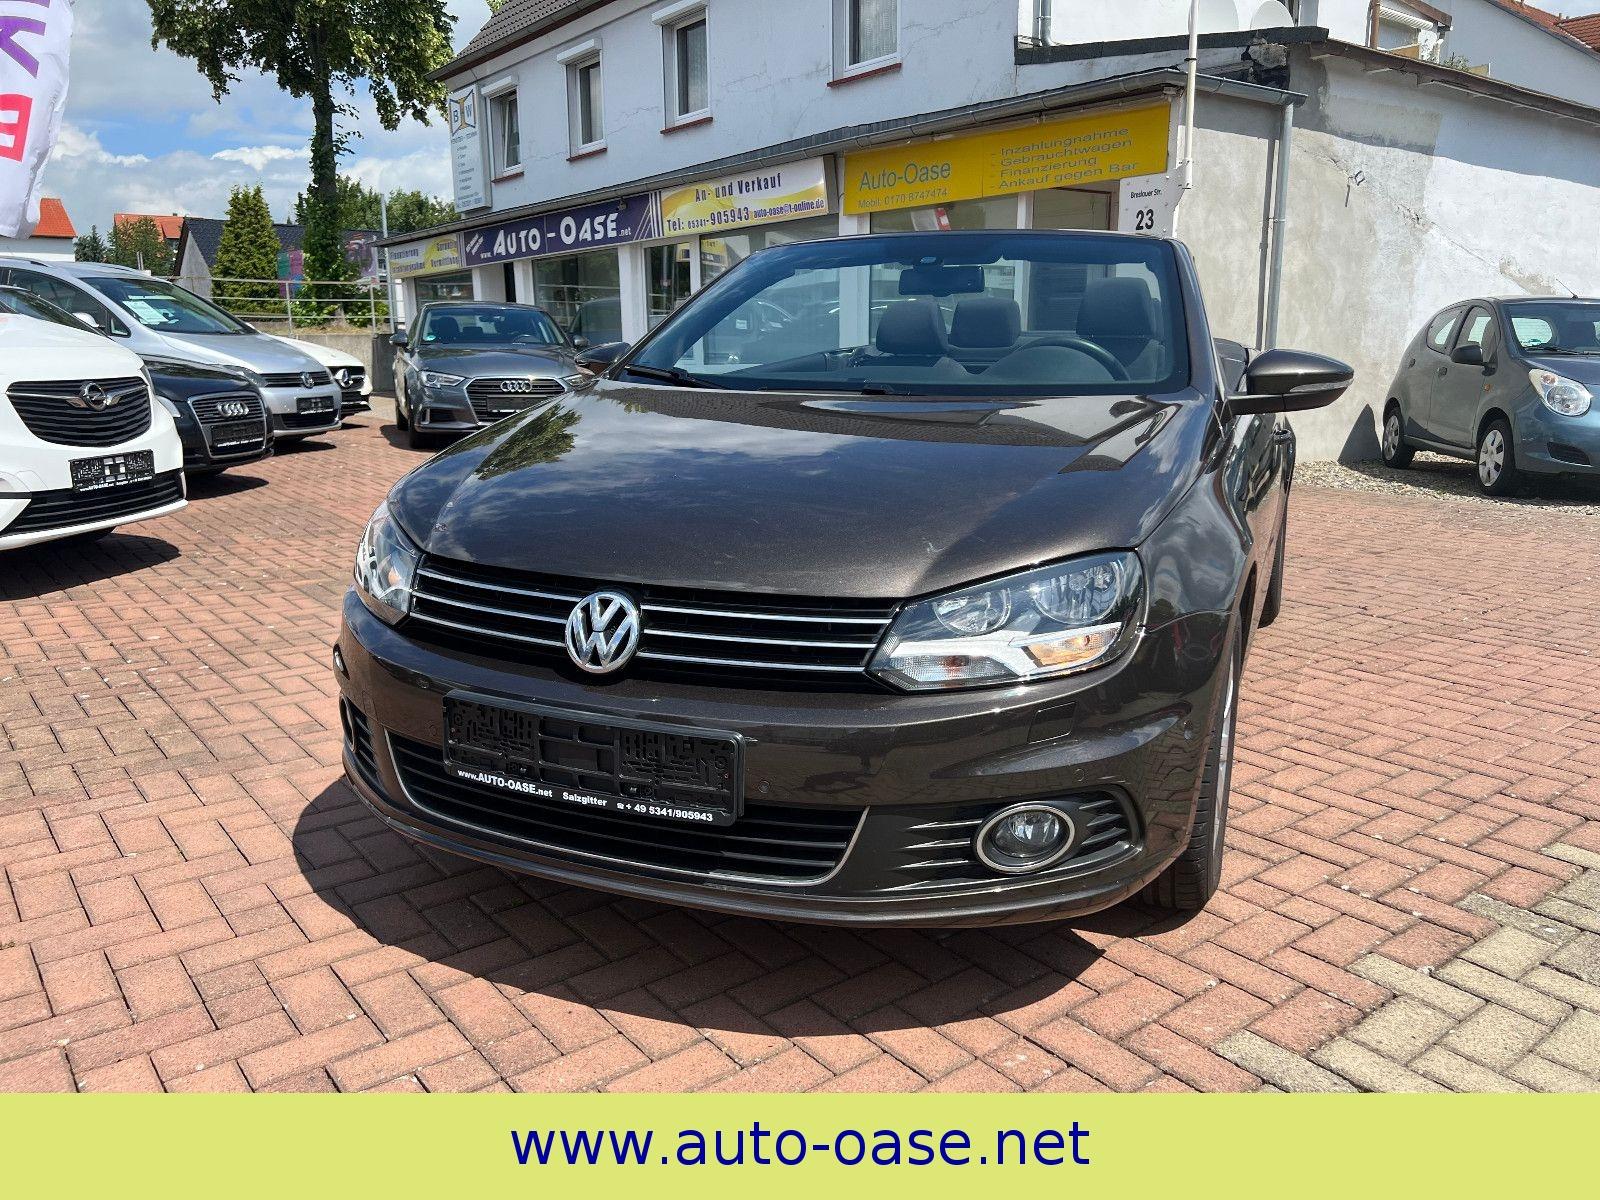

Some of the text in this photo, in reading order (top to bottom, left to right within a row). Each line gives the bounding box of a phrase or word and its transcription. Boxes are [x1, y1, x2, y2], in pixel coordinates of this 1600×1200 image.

[452, 109, 459, 123] B
[1000, 139, 1132, 167] Gebrauchtwagen
[1001, 127, 1129, 155] Inzahlungnahme
[859, 162, 951, 191] Auto-Oase
[999, 162, 1137, 188] Ankauf gegen Bar
[1001, 157, 1097, 177] Finanzierung
[695, 172, 782, 203] An- und Verkauf
[884, 194, 906, 206] 0170
[1130, 188, 1163, 199] Breslauer Str.
[667, 218, 685, 232] Tel:
[753, 198, 825, 219] auto-oase@t-online.de
[1135, 208, 1154, 231] 23
[493, 227, 541, 256] AUTO
[559, 212, 619, 245] OASE
[566, 592, 639, 673] VW
[457, 769, 553, 798] www.AUTO-OASE.net
[562, 791, 607, 807] Salzgitter
[634, 803, 647, 813] 49
[648, 806, 713, 822] 5341/905943
